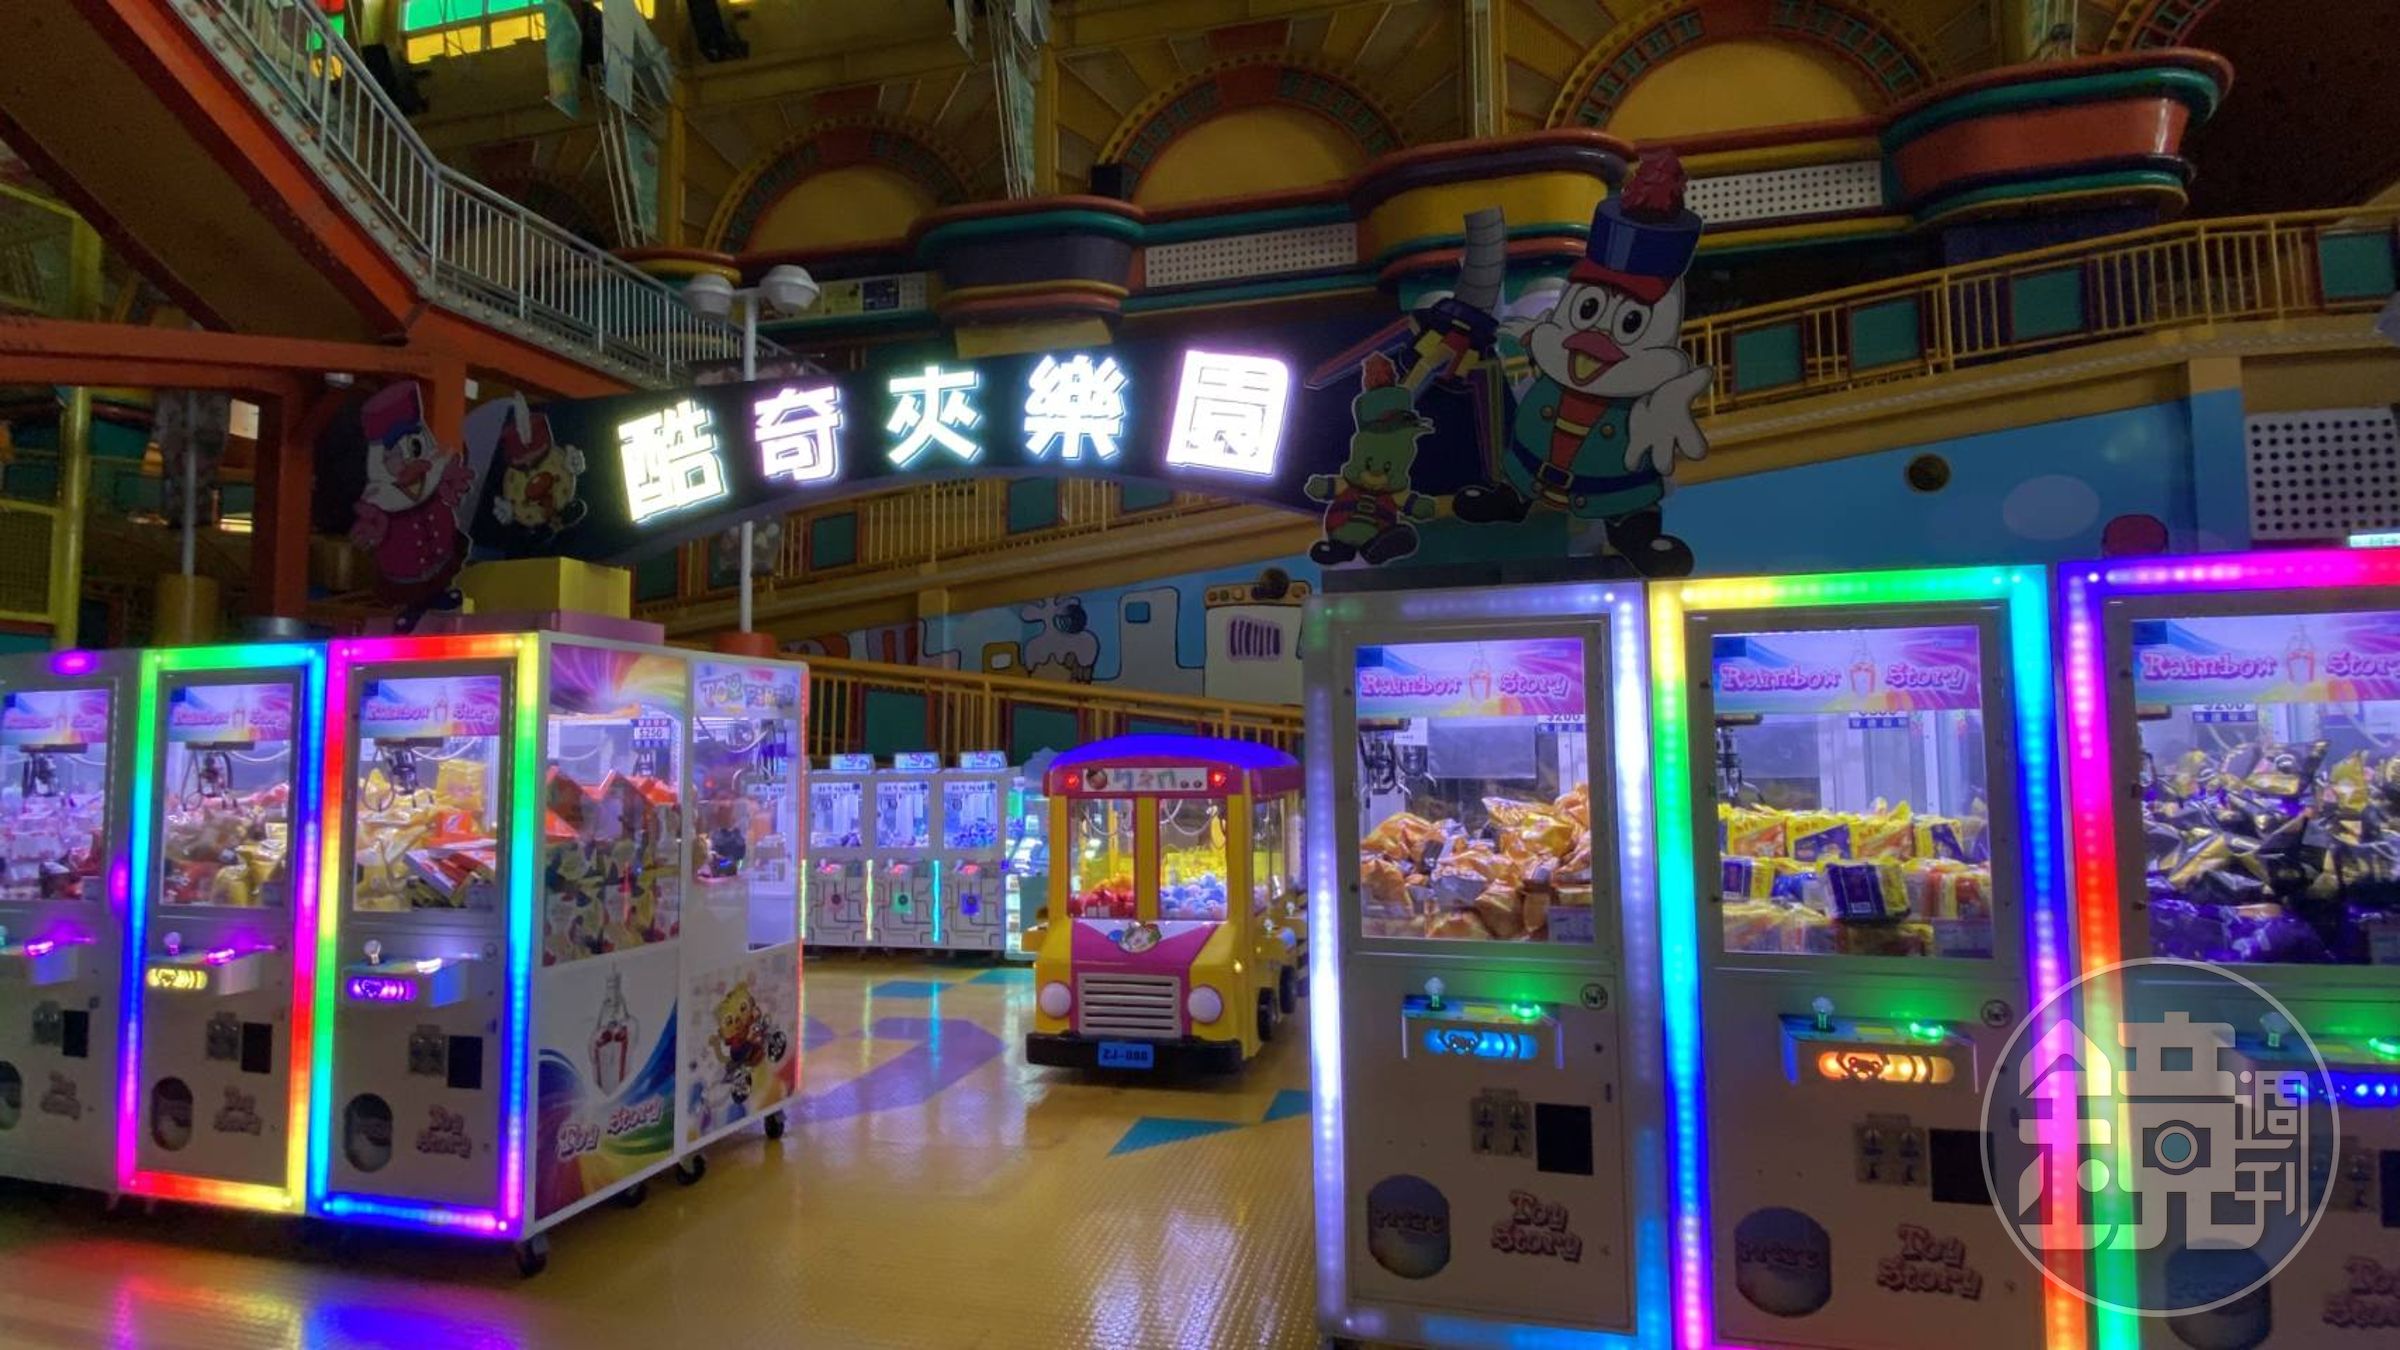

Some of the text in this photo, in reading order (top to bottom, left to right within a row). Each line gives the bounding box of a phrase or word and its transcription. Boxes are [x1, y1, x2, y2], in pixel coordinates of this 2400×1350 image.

[618, 350, 1289, 523] 酷奇夾樂園
[1360, 668, 1570, 697] Rainbow Story
[1721, 661, 1969, 692] Rainbow Story
[2141, 650, 2400, 681] Rainbow Stor
[1508, 1189, 1568, 1233] Toy
[1491, 1221, 1582, 1263] Story
[1898, 1223, 1966, 1269] Toy
[1876, 1254, 1983, 1301] Story
